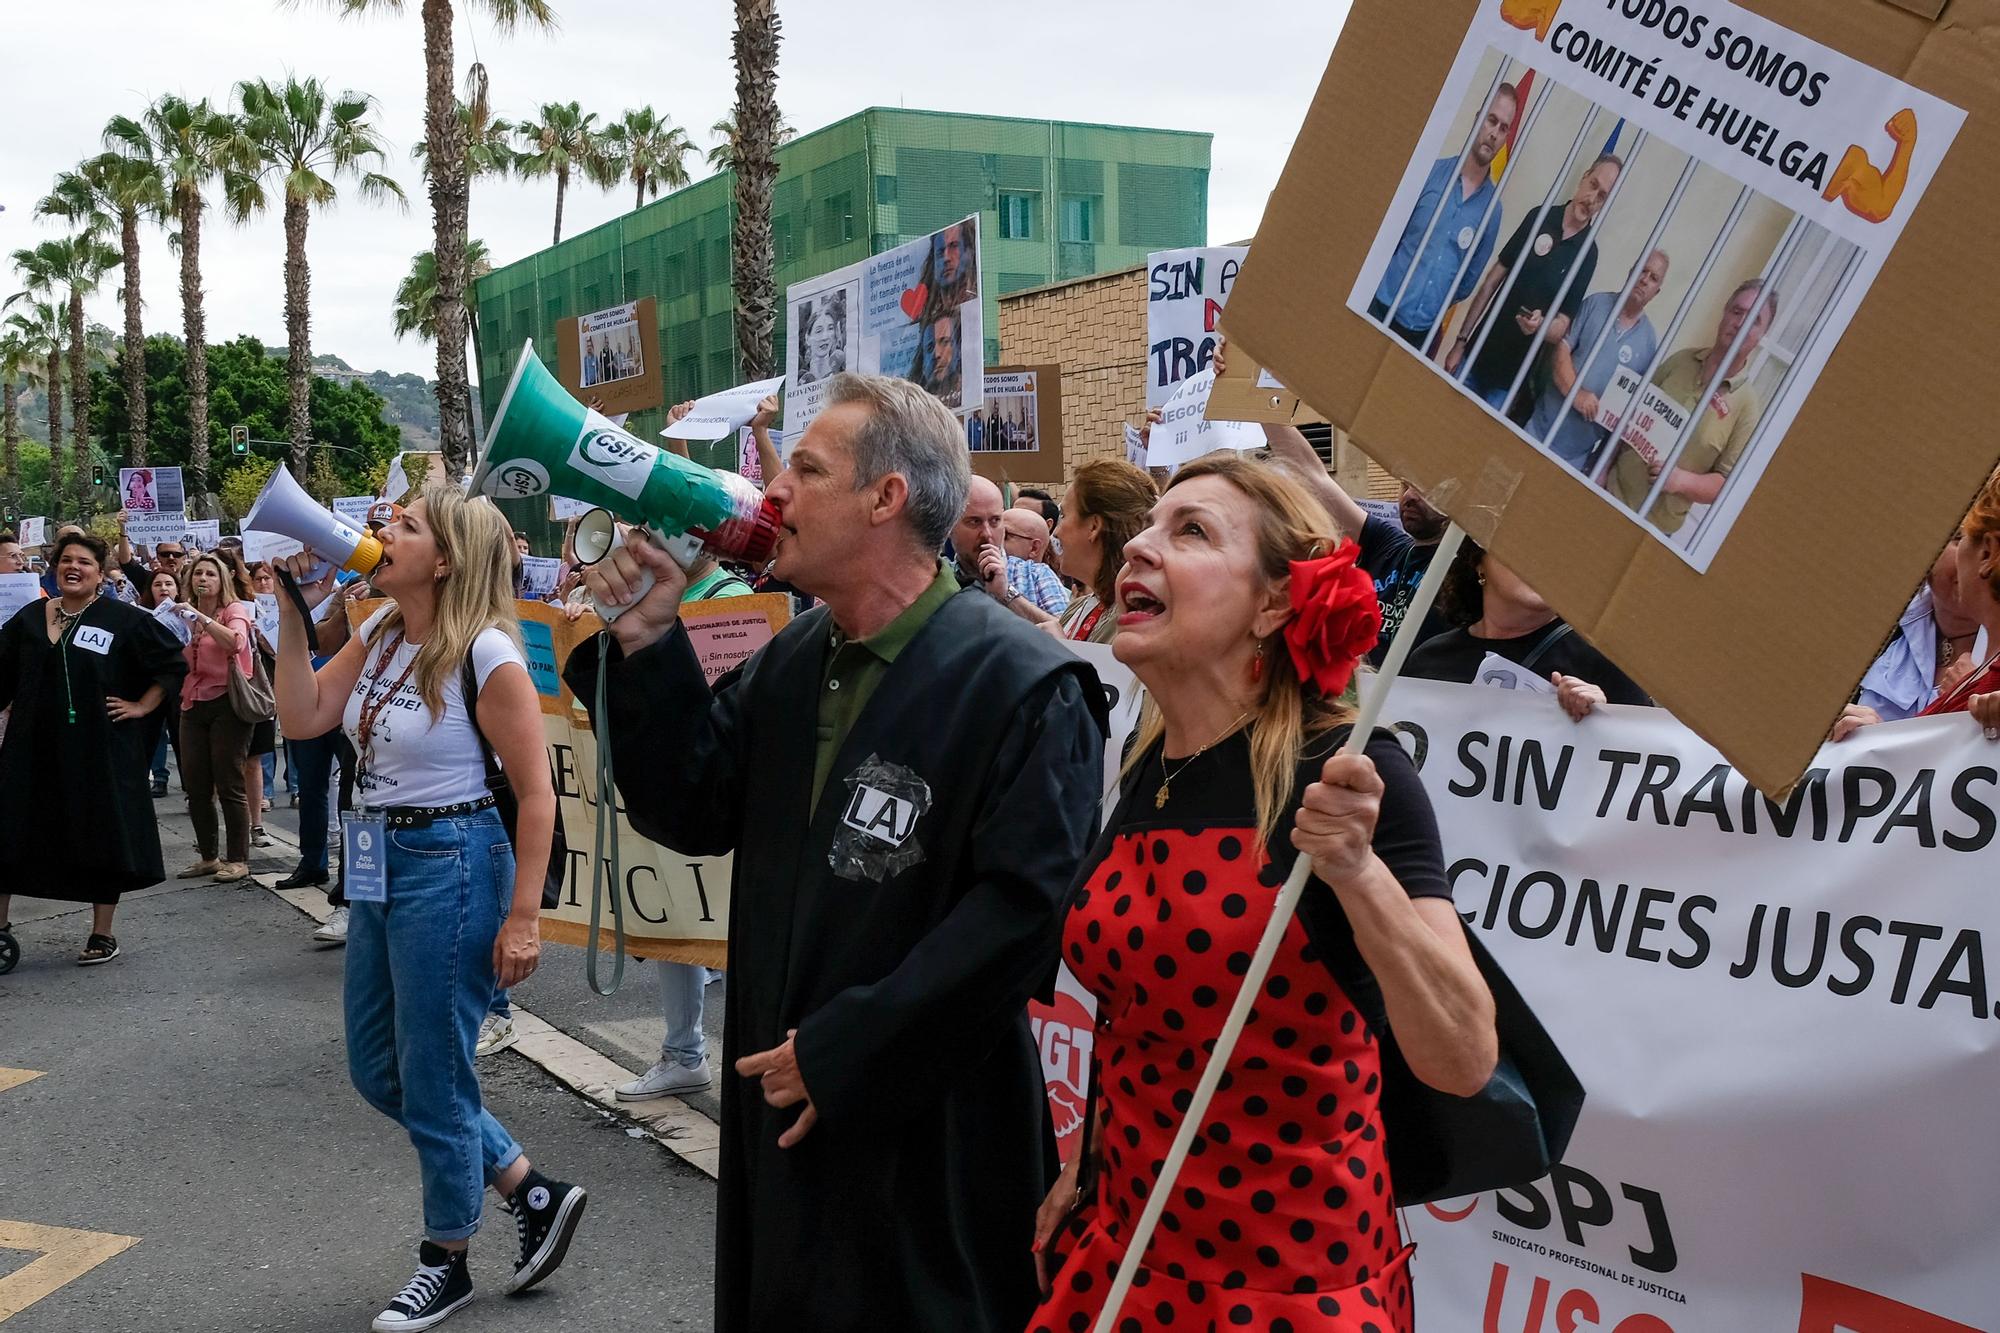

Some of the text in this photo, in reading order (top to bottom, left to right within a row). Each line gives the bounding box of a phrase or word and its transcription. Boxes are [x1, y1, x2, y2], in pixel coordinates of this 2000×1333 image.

[1607, 0, 1830, 107] ODOS SOMOS
[1550, 22, 1830, 192] COMITÉ DE HUELGA
[1150, 257, 1205, 301] SIN
[609, 308, 626, 317] SOMOS
[1617, 375, 1629, 390] NO
[1643, 392, 1653, 406] LA
[1653, 399, 1684, 430] ESPALDA
[1196, 421, 1212, 434] YA
[144, 513, 185, 521] JUSTICIA
[126, 524, 186, 532] NEGOCIACIÓN
[686, 621, 730, 632] UNCIONARIOS
[742, 617, 767, 625] JUSTICIA
[81, 631, 106, 648] LAJ
[723, 631, 747, 639] HUELGA
[709, 652, 722, 661] Sin
[354, 684, 369, 699] SE
[377, 676, 425, 696] JUSTICI
[1448, 731, 1574, 811] SIN
[1596, 748, 1998, 853] TRAMPAS
[846, 785, 915, 842] LAJ
[358, 854, 372, 862] Ana
[1729, 903, 2000, 1020] JUSTA
[1492, 1229, 1687, 1305] SINDICATO PROFESIONAL DE JUSTICIA
